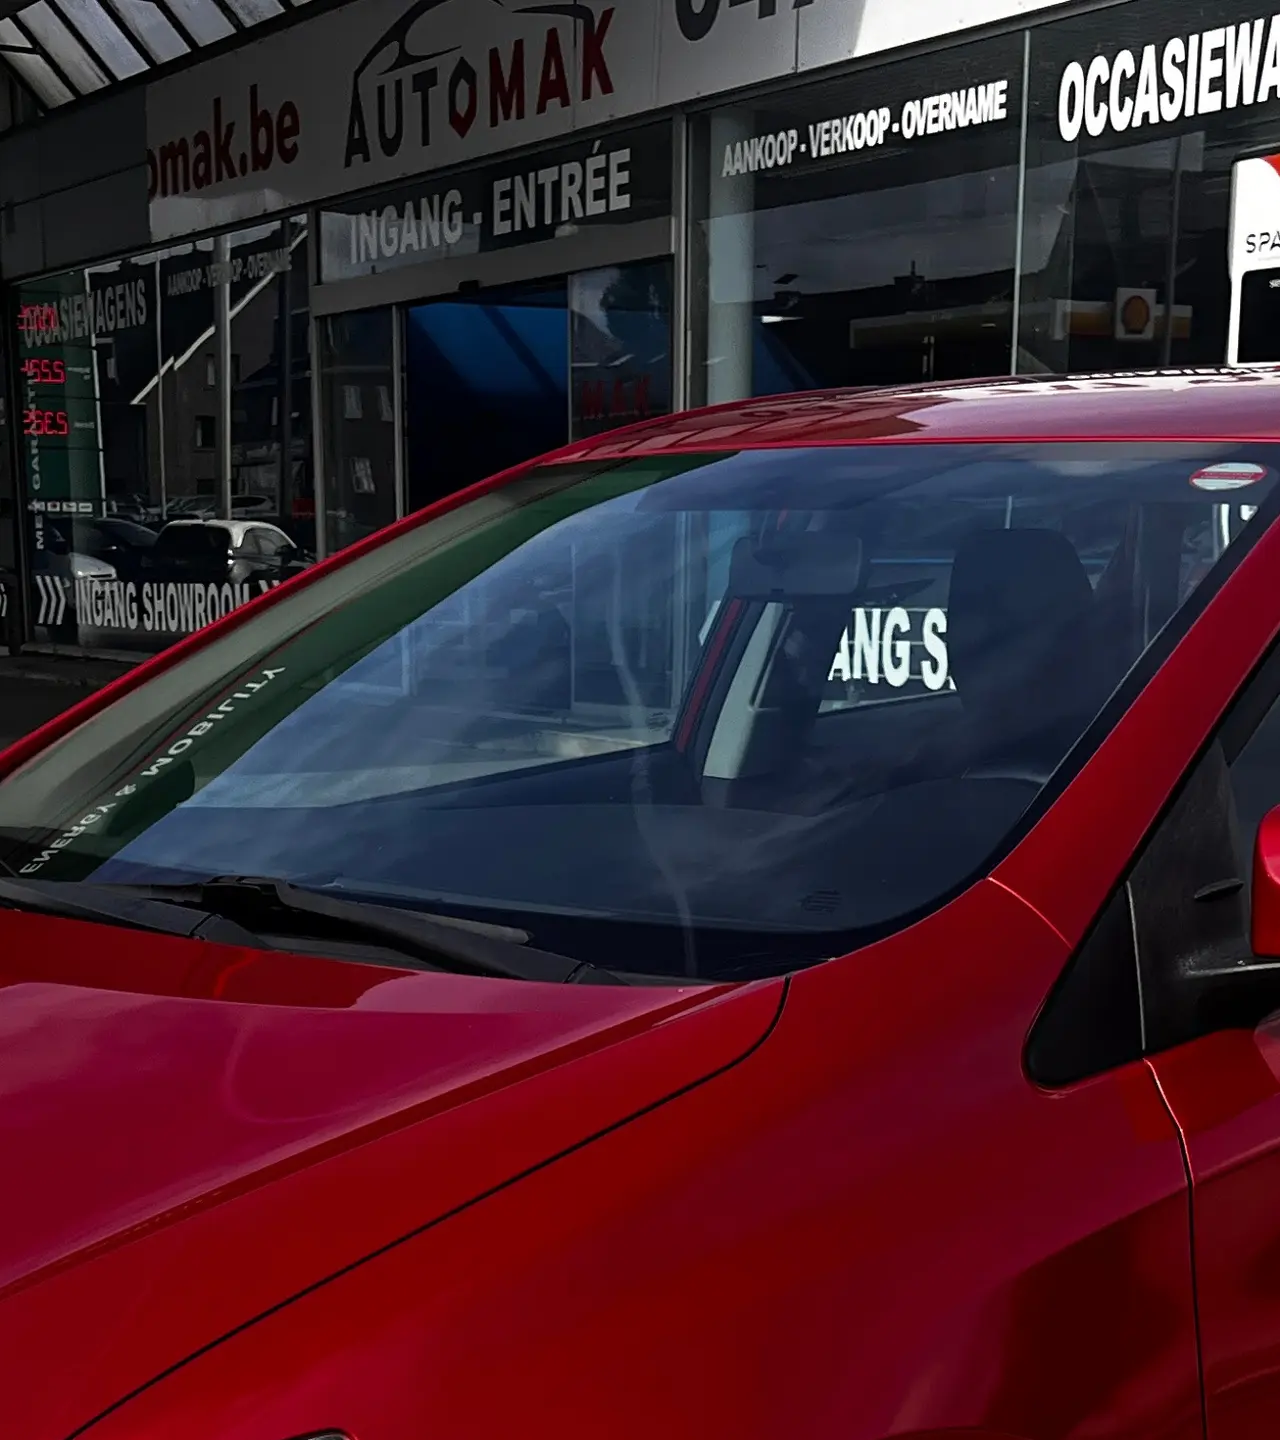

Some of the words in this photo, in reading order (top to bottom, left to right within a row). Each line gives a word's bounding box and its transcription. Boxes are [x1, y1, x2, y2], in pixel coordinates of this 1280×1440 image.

[344, 7, 614, 168] AUTOMAK
[722, 129, 798, 177] AANKOOP
[808, 107, 891, 158] VERKOOP
[901, 80, 1008, 139] OVERNAME
[350, 189, 462, 264] INGANG
[493, 140, 632, 236] ENTRÉE
[74, 580, 139, 631] INGANG
